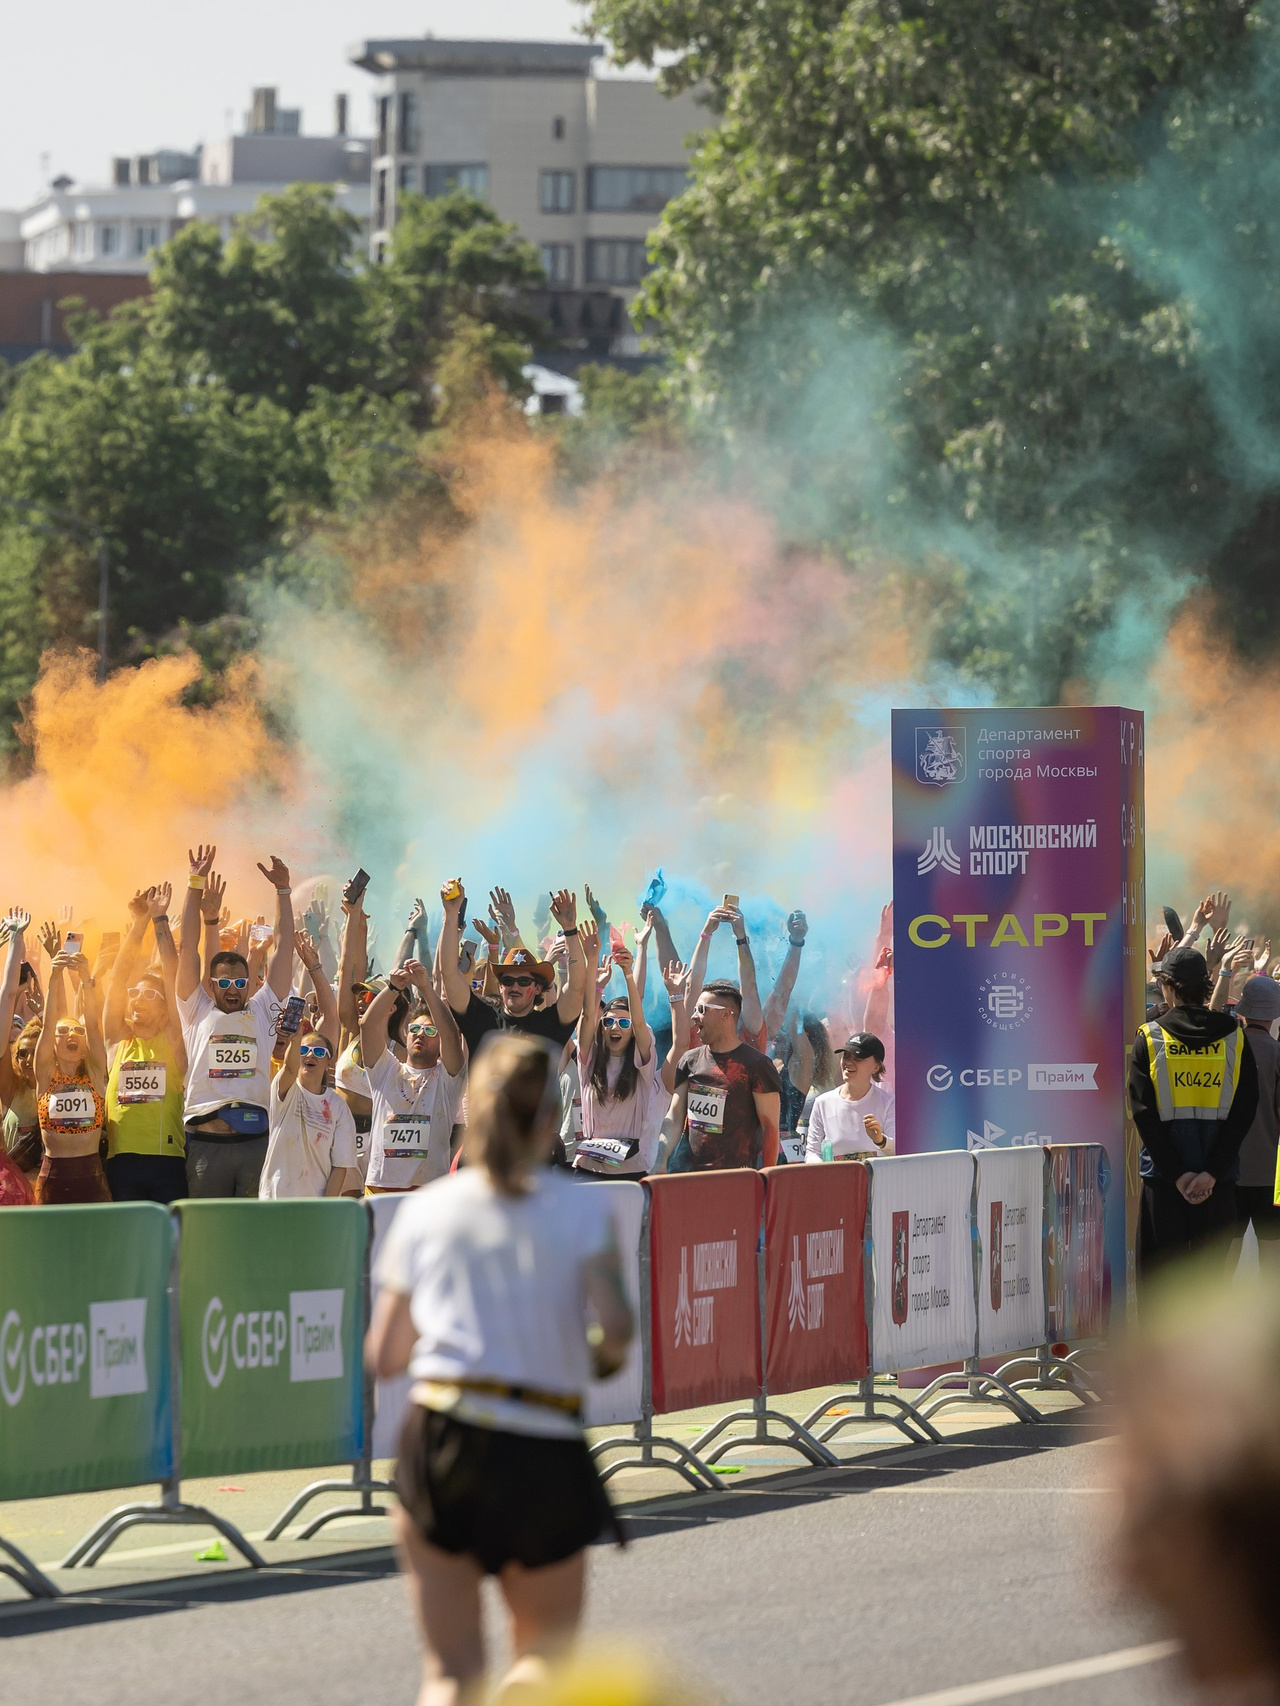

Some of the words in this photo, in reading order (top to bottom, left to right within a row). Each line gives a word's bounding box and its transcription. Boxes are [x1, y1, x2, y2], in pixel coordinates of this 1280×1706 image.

[977, 727, 1081, 744] Департамент
[978, 750, 1031, 763] спорта
[978, 768, 1032, 782] города
[1036, 764, 1098, 778] Москвы
[969, 819, 1097, 849] МОСКОВСКИЙ
[969, 851, 1030, 876] СПОРТ
[908, 912, 1107, 949] СТАРТ
[979, 971, 1032, 991] БЕГОВОЕ
[978, 1005, 1034, 1032] СООБЩЕСТВО
[215, 1049, 250, 1063] 5265
[125, 1076, 159, 1090] 5566
[959, 1068, 1022, 1087] СБЕР
[1036, 1069, 1085, 1086] Прайм
[55, 1098, 88, 1112] 5091
[689, 1100, 718, 1117] 4460
[390, 1129, 421, 1143] 7471
[1010, 1131, 1052, 1147] сбп
[912, 1213, 946, 1243] Департамент
[231, 1309, 287, 1370] СБЕР
[29, 1321, 87, 1387] СБЕР
